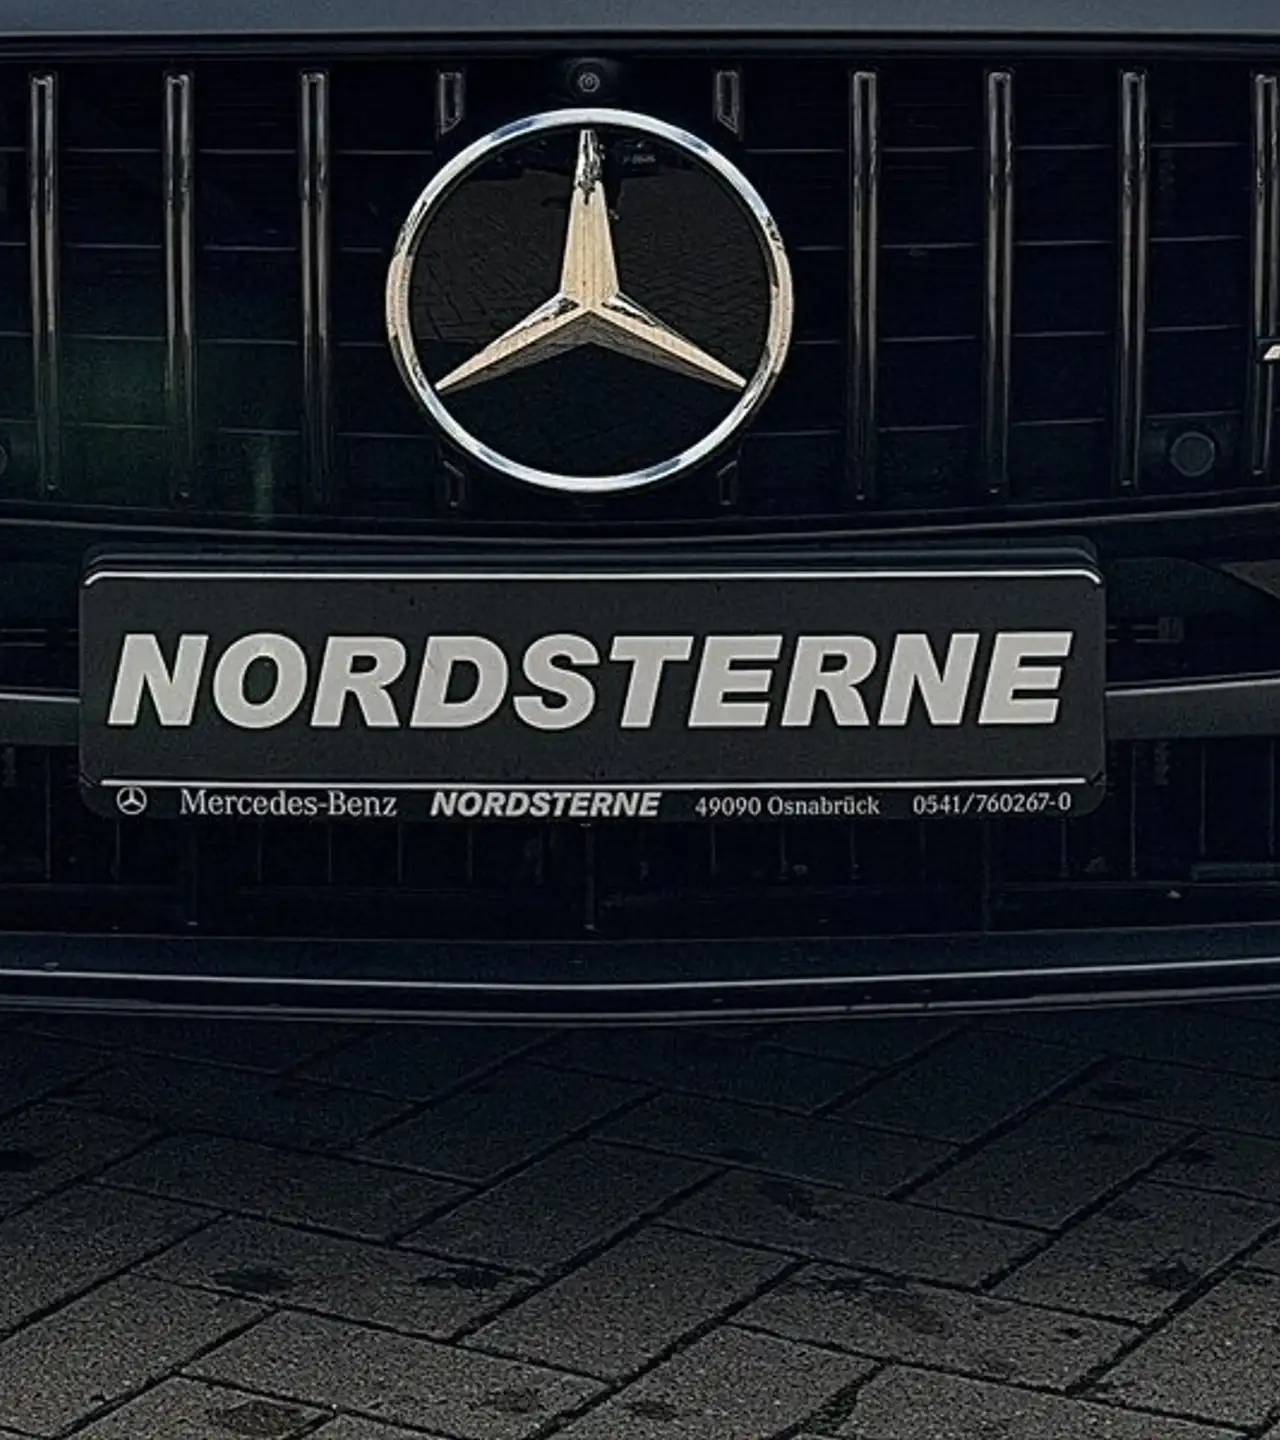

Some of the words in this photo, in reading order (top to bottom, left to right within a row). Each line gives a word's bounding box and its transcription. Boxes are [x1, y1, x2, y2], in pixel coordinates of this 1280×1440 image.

[107, 631, 1074, 729] NORDSTERNE
[180, 790, 398, 817] Mercedes-Benz
[429, 791, 662, 818] NORDSTERNE
[694, 796, 762, 817] 49090
[766, 794, 881, 817] Osnabrück
[912, 791, 1073, 815] 0541/760267-0
